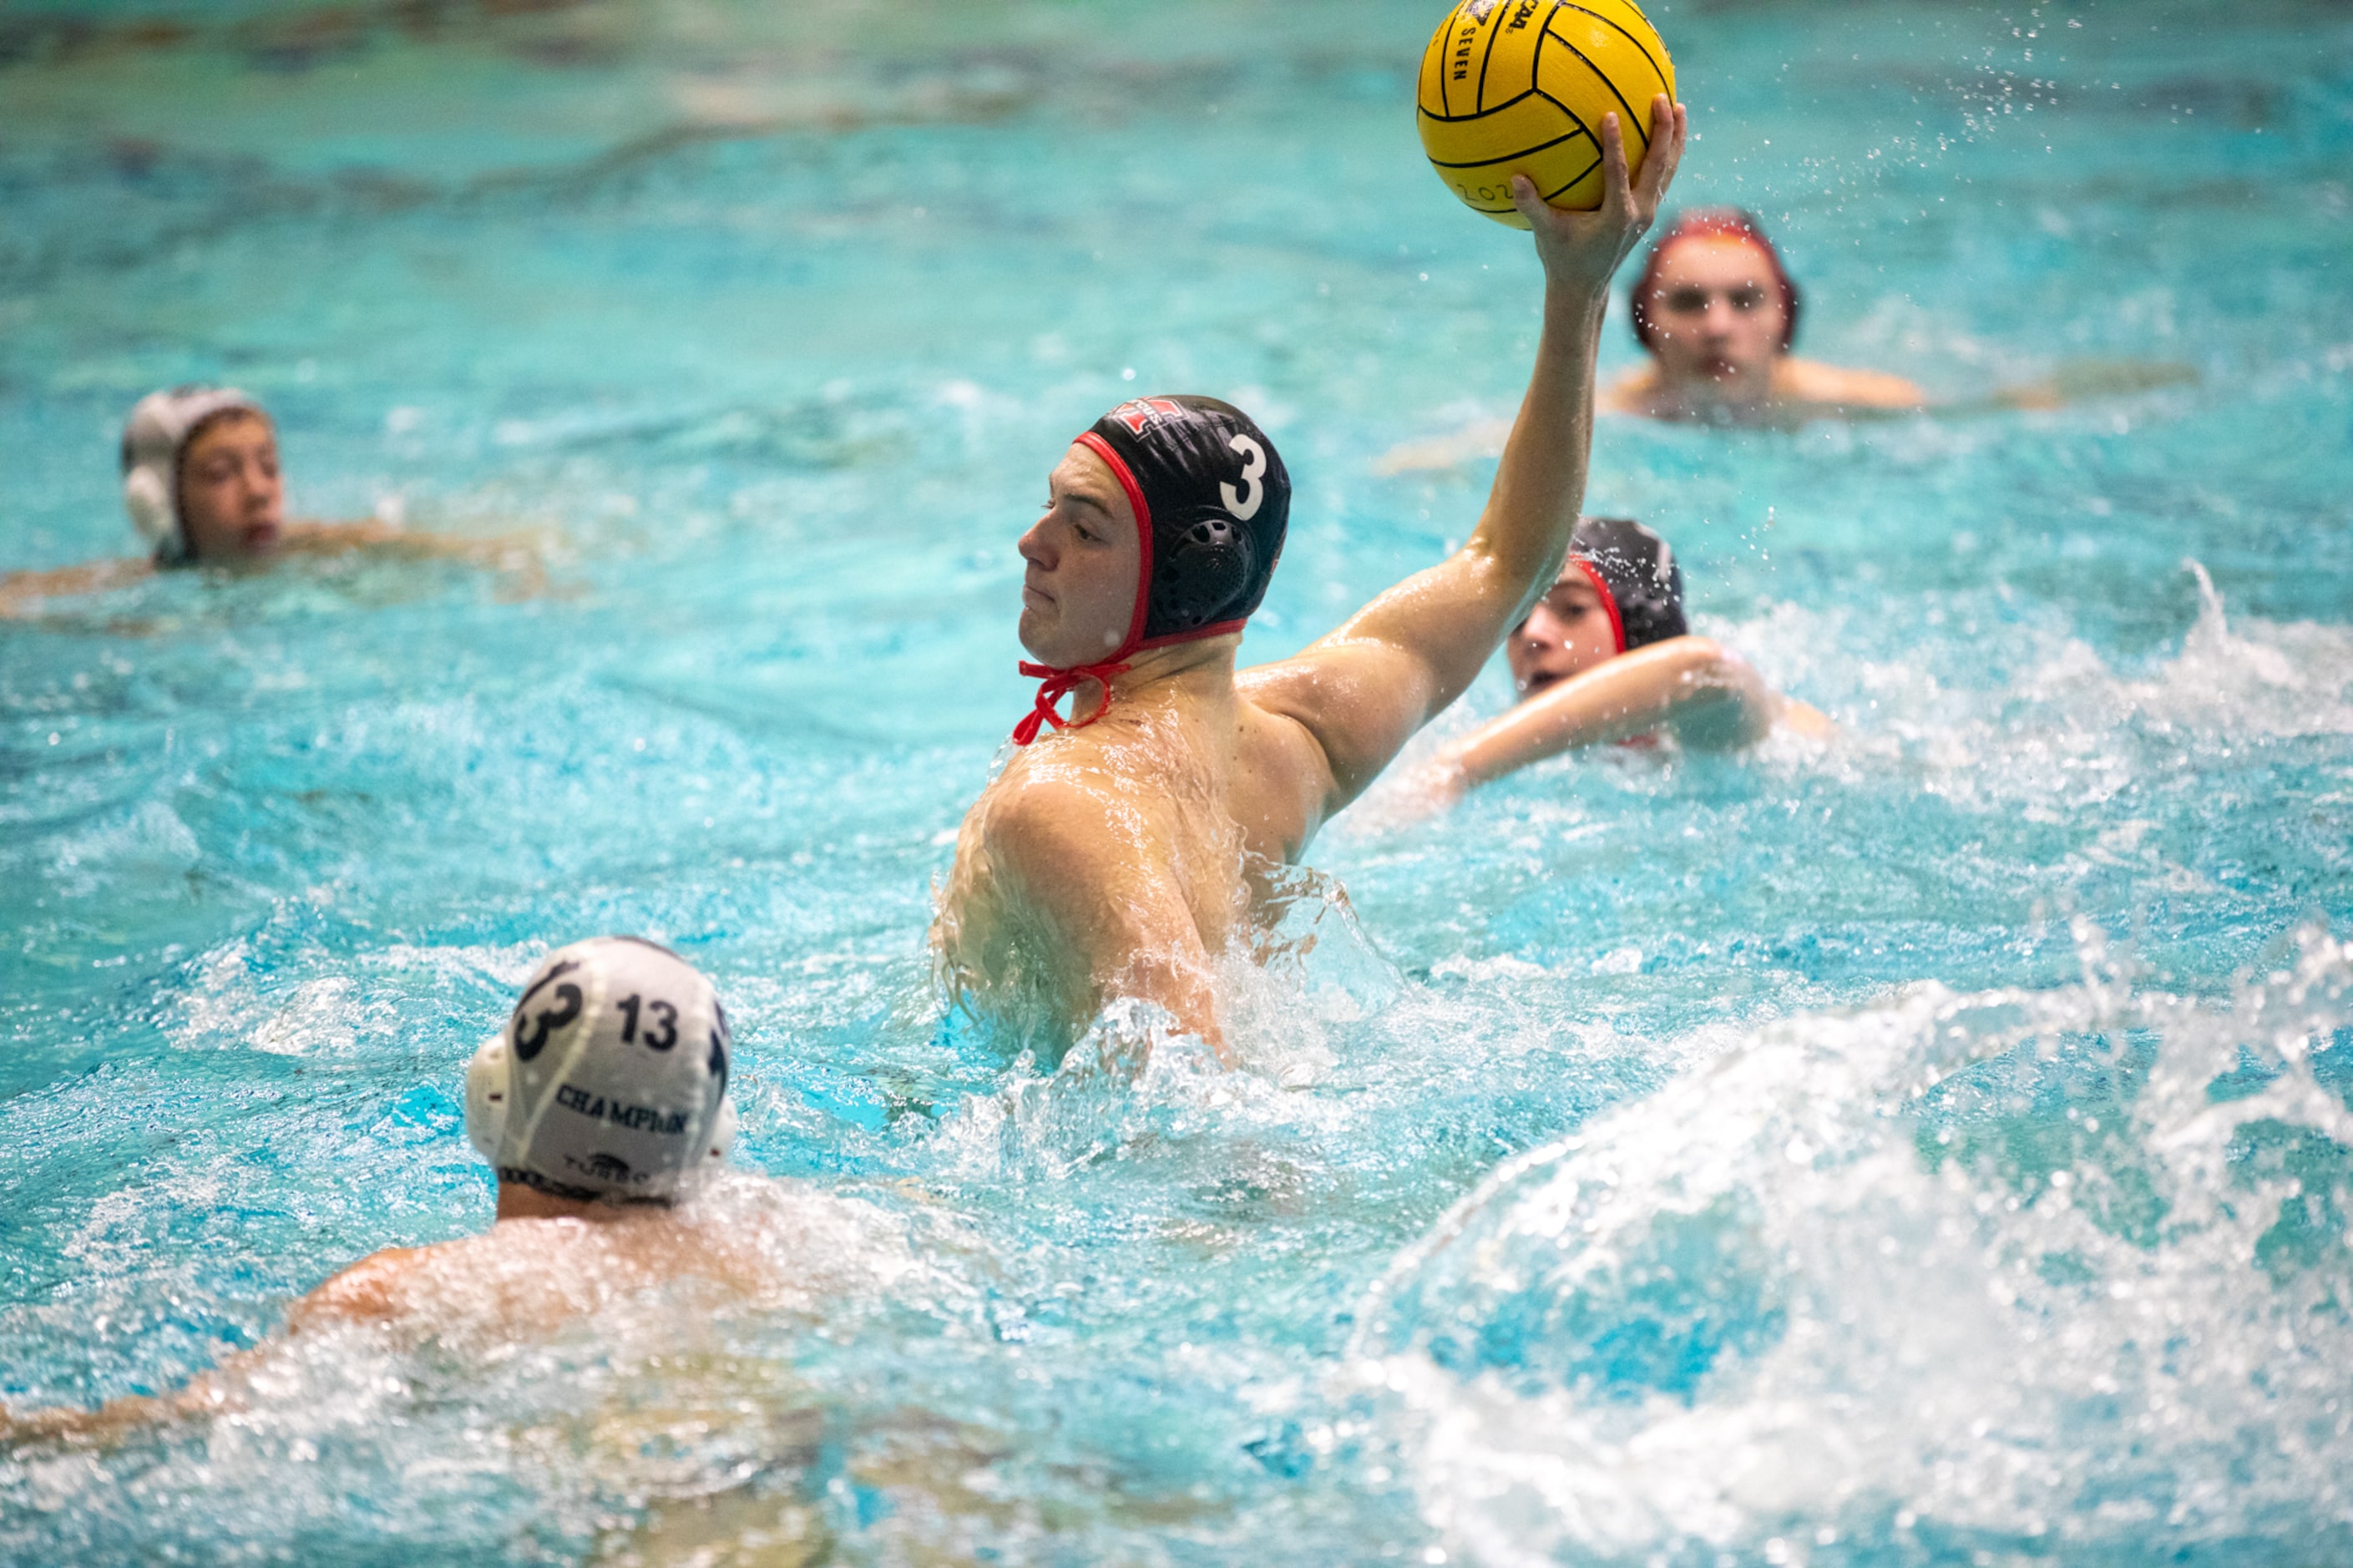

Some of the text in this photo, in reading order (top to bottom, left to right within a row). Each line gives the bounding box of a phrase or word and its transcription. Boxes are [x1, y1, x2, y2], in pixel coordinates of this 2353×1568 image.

[1510, 0, 1539, 29] CAA
[1453, 27, 1476, 81] SEVEN
[1456, 183, 1514, 201] 202
[1219, 432, 1267, 521] 3
[615, 993, 679, 1053] 13
